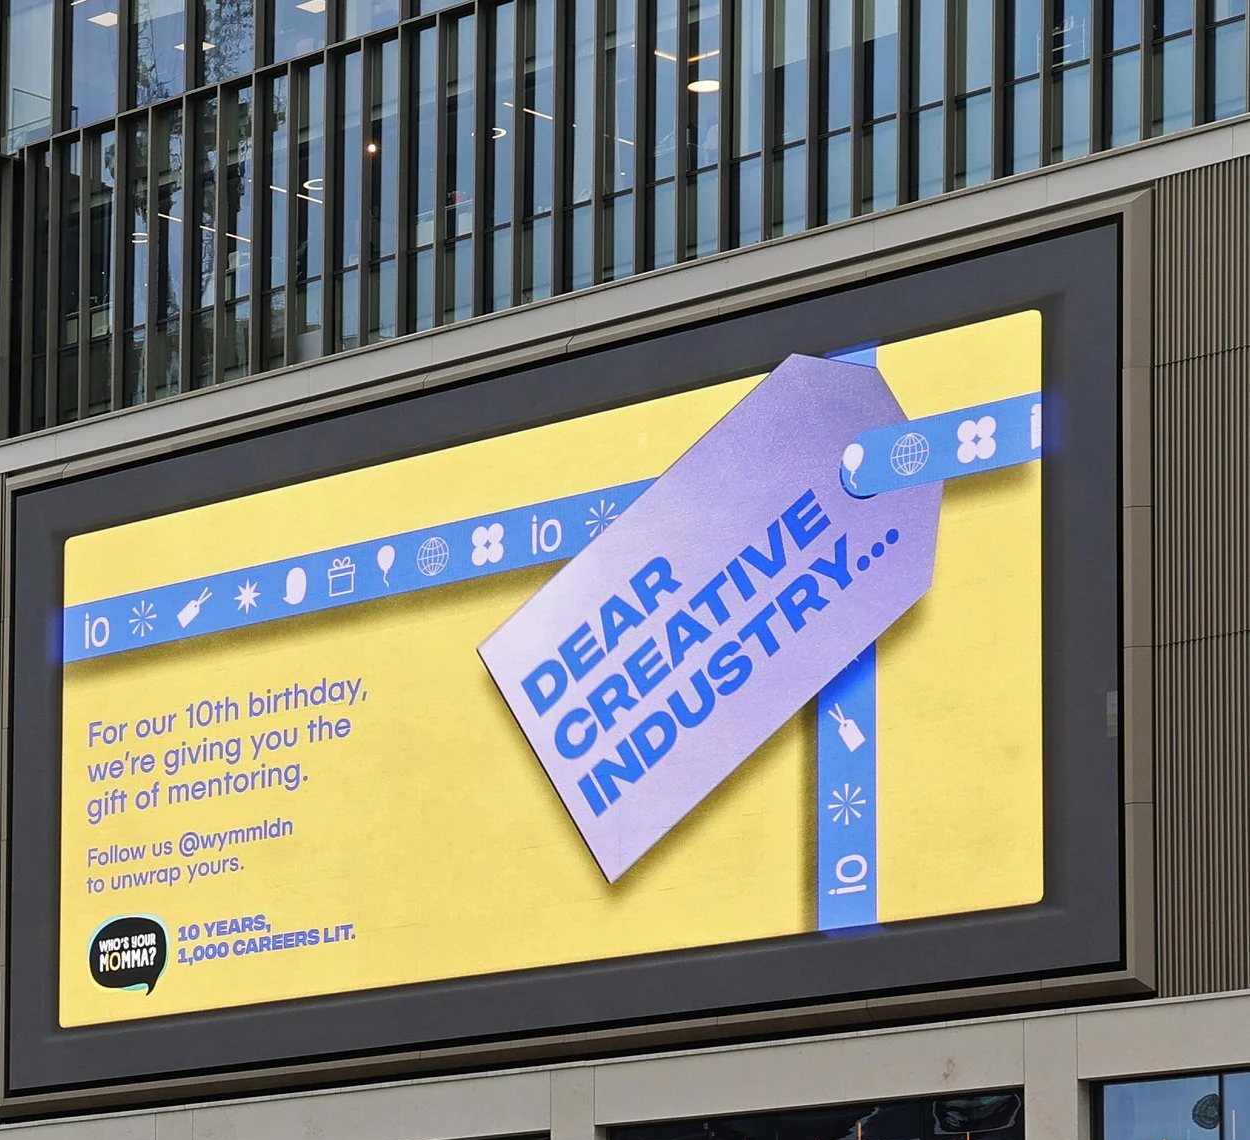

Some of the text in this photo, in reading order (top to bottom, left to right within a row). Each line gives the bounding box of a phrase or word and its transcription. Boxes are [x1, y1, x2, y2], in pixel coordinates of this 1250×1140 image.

[520, 556, 683, 718] DEAR
[554, 488, 831, 760] CREATIVE
[577, 528, 899, 817] INDUSTRY...
[88, 677, 368, 748] For our 10th birthday,
[87, 715, 351, 783] we're giving you the
[87, 763, 309, 825] gift of mentoring.
[87, 817, 294, 868] Follow us @wymmldn
[86, 856, 245, 894] to unwrap yours.
[98, 932, 157, 953] WHO'S YOUR
[177, 914, 272, 942] 10 YEARS,
[177, 924, 357, 967] 1,000 CAREERS LIT.
[98, 948, 157, 974] MOMMA?
